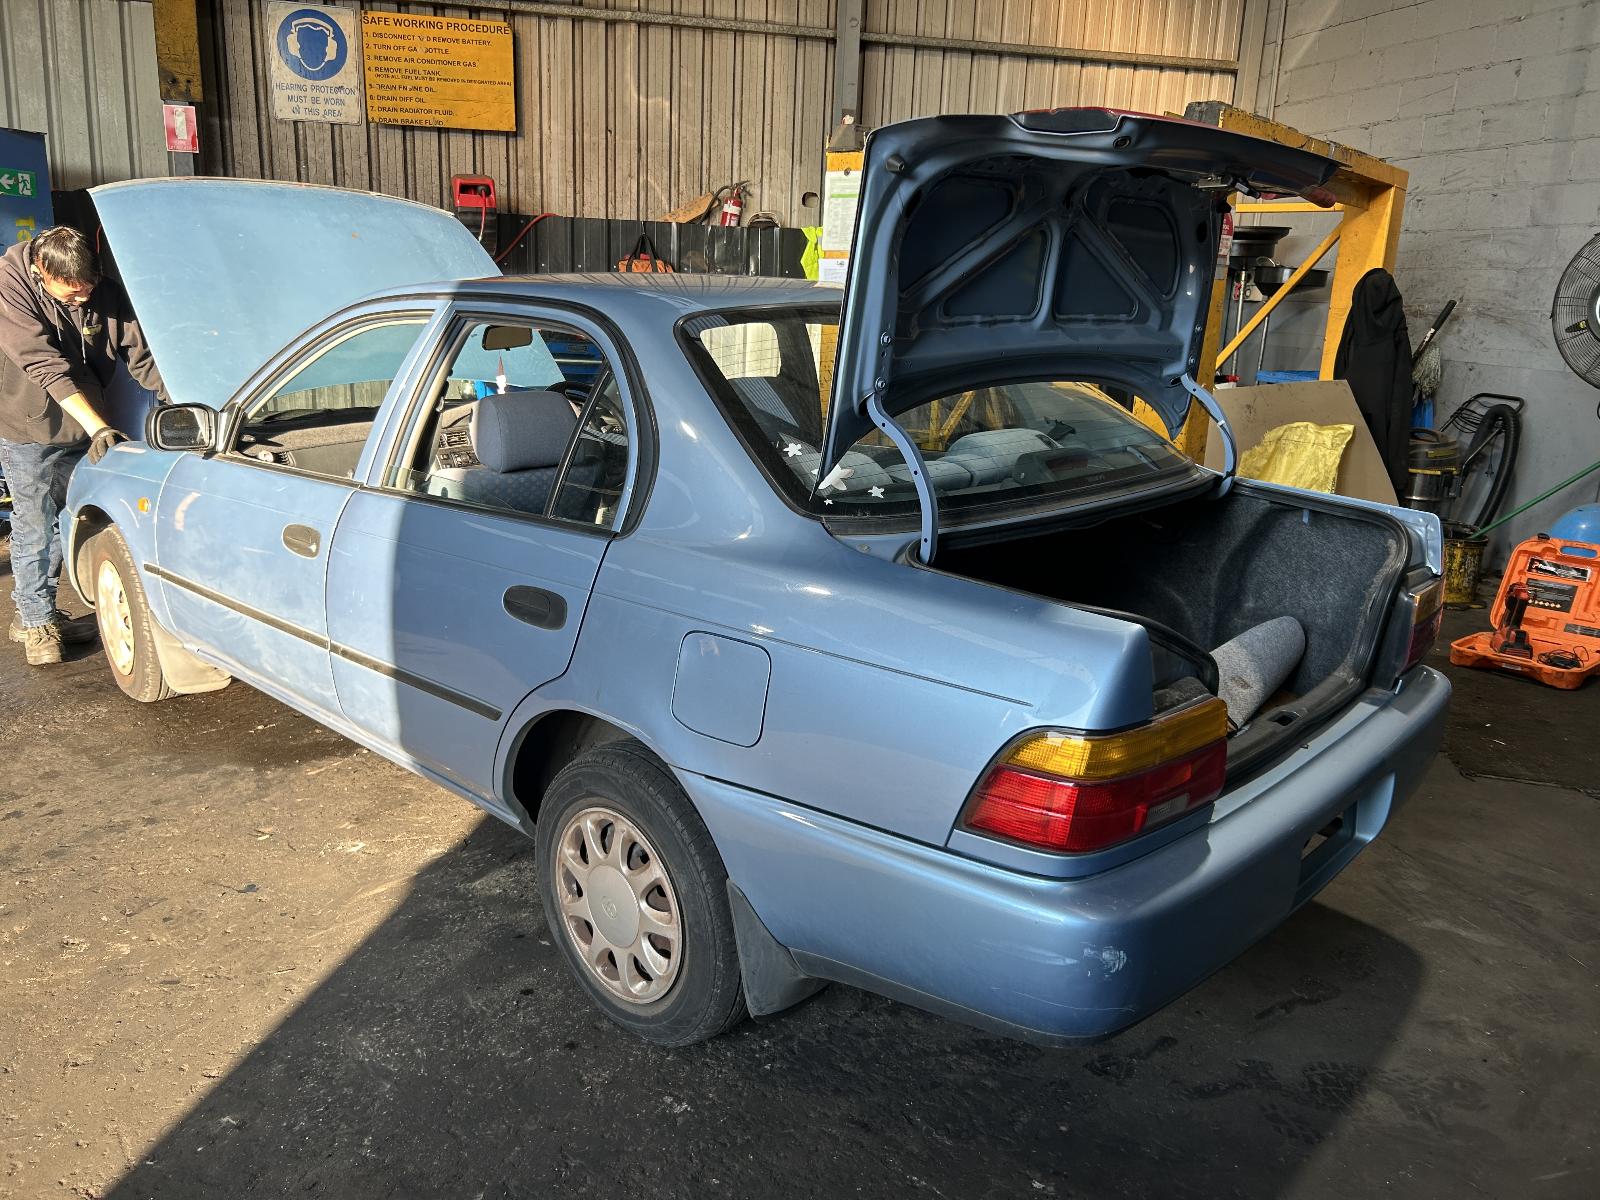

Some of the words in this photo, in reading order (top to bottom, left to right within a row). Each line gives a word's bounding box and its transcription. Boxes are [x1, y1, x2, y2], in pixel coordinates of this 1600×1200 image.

[363, 16, 390, 26] SAFE
[392, 18, 443, 30] WORKING
[446, 22, 510, 34] PROCEDURE
[372, 32, 415, 41] DISCONNECT
[432, 36, 460, 44] REMOVE
[373, 43, 391, 51] TURN
[417, 58, 461, 66] CONDITIONER
[275, 82, 308, 92] HEARING
[310, 84, 356, 96] PROTECTION
[287, 94, 307, 103] MUST
[310, 96, 321, 105] BE
[323, 97, 345, 107] WORN
[377, 94, 398, 102] DRAIN
[304, 107, 320, 116] THIS
[323, 109, 342, 118] AREA
